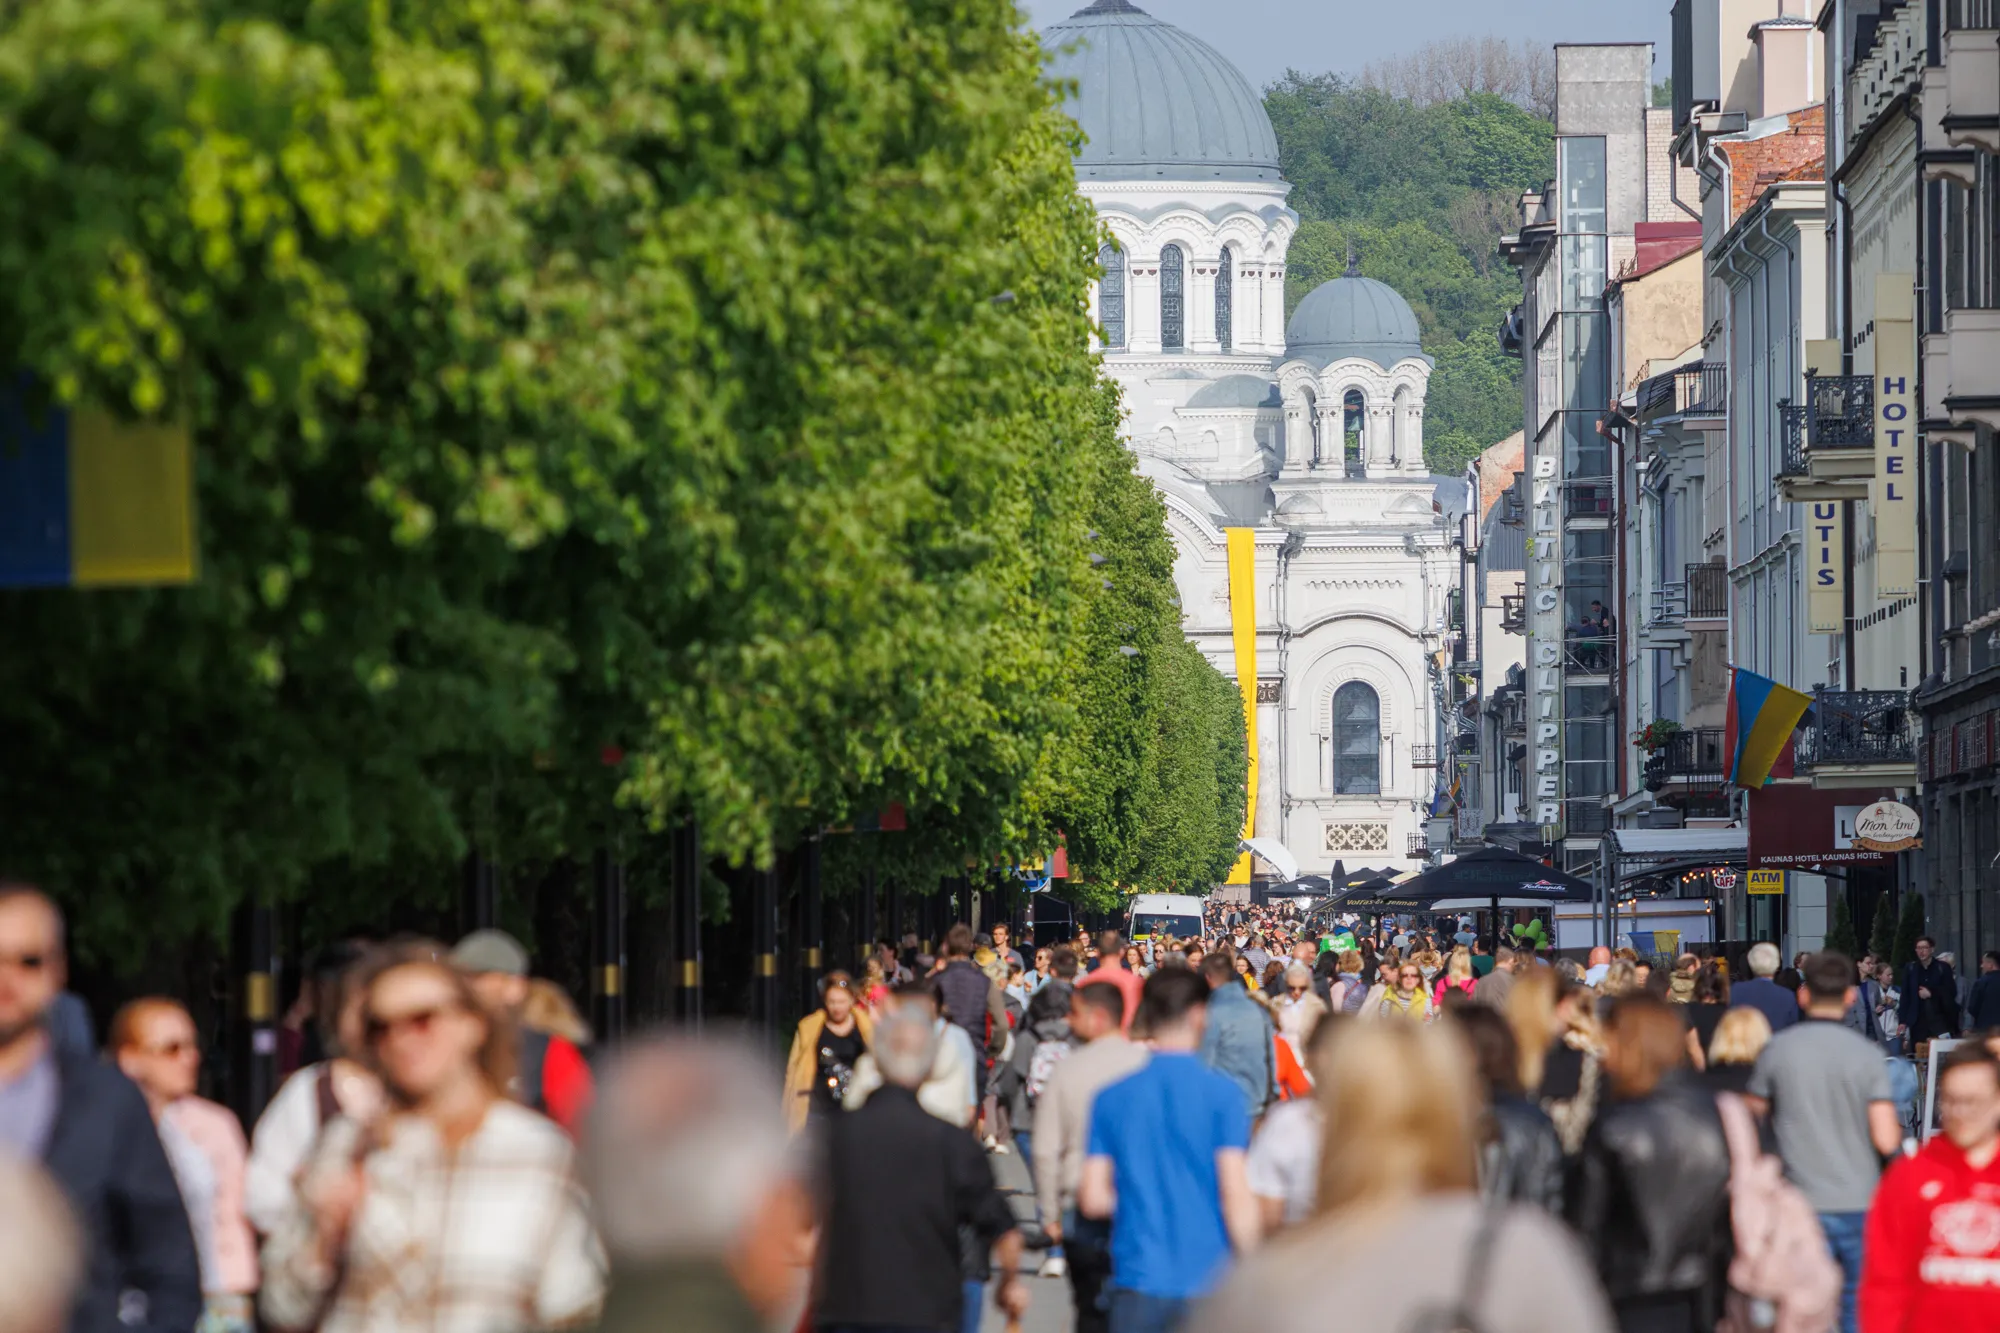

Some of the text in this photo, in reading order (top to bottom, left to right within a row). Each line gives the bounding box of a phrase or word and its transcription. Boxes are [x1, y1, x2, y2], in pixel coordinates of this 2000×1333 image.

[1883, 377, 1907, 501] HOTEL
[1534, 456, 1560, 824] BALTIC CLIPPER
[1860, 818, 1916, 831] Mon Ami
[1761, 852, 1883, 863] KAUNAS HOTEL KAUNAS HOTEL
[1751, 873, 1780, 882] ATM
